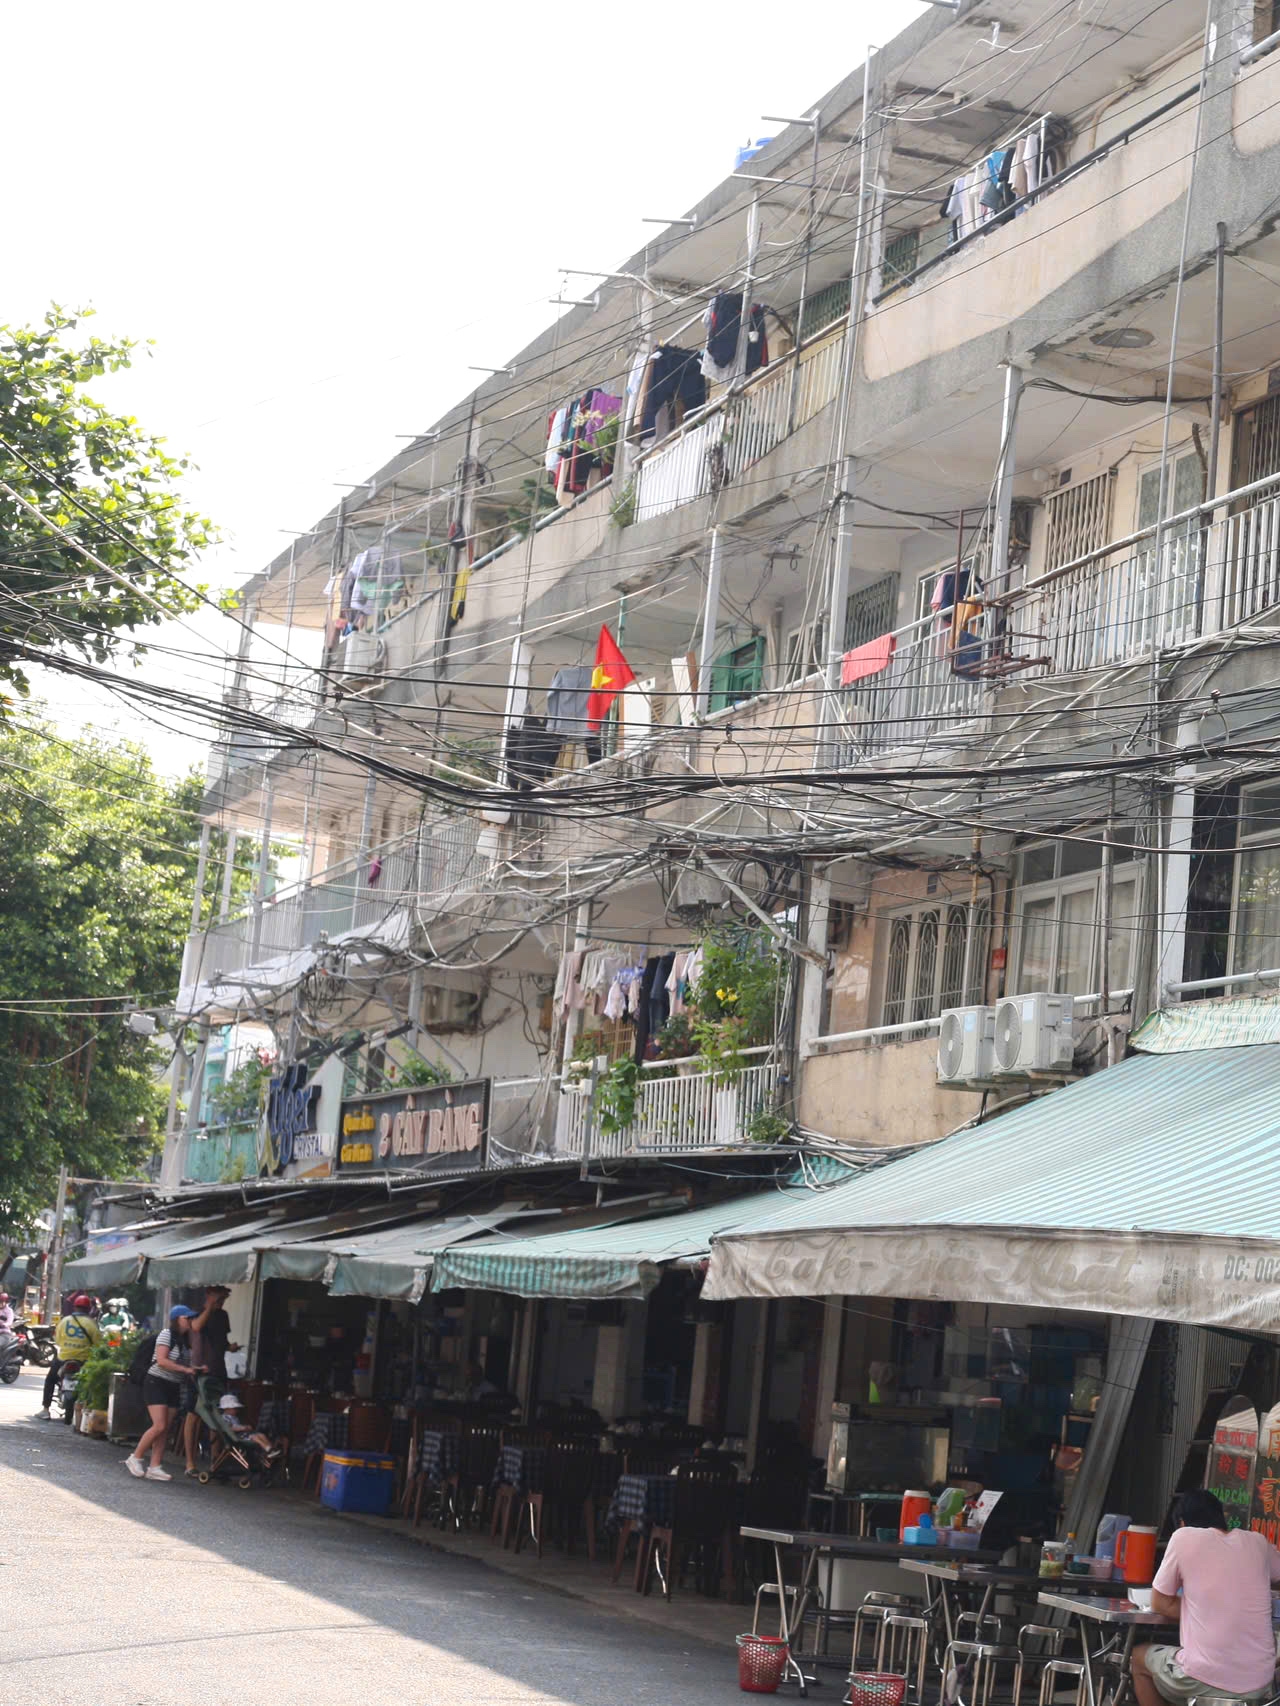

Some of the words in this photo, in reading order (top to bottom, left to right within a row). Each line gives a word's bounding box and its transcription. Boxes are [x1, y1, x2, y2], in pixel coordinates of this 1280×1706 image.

[392, 1094, 428, 1157] CÂY
[427, 1088, 483, 1155] BÀNG
[1224, 1255, 1250, 1282] ĐC:
[66, 1320, 86, 1339] be
